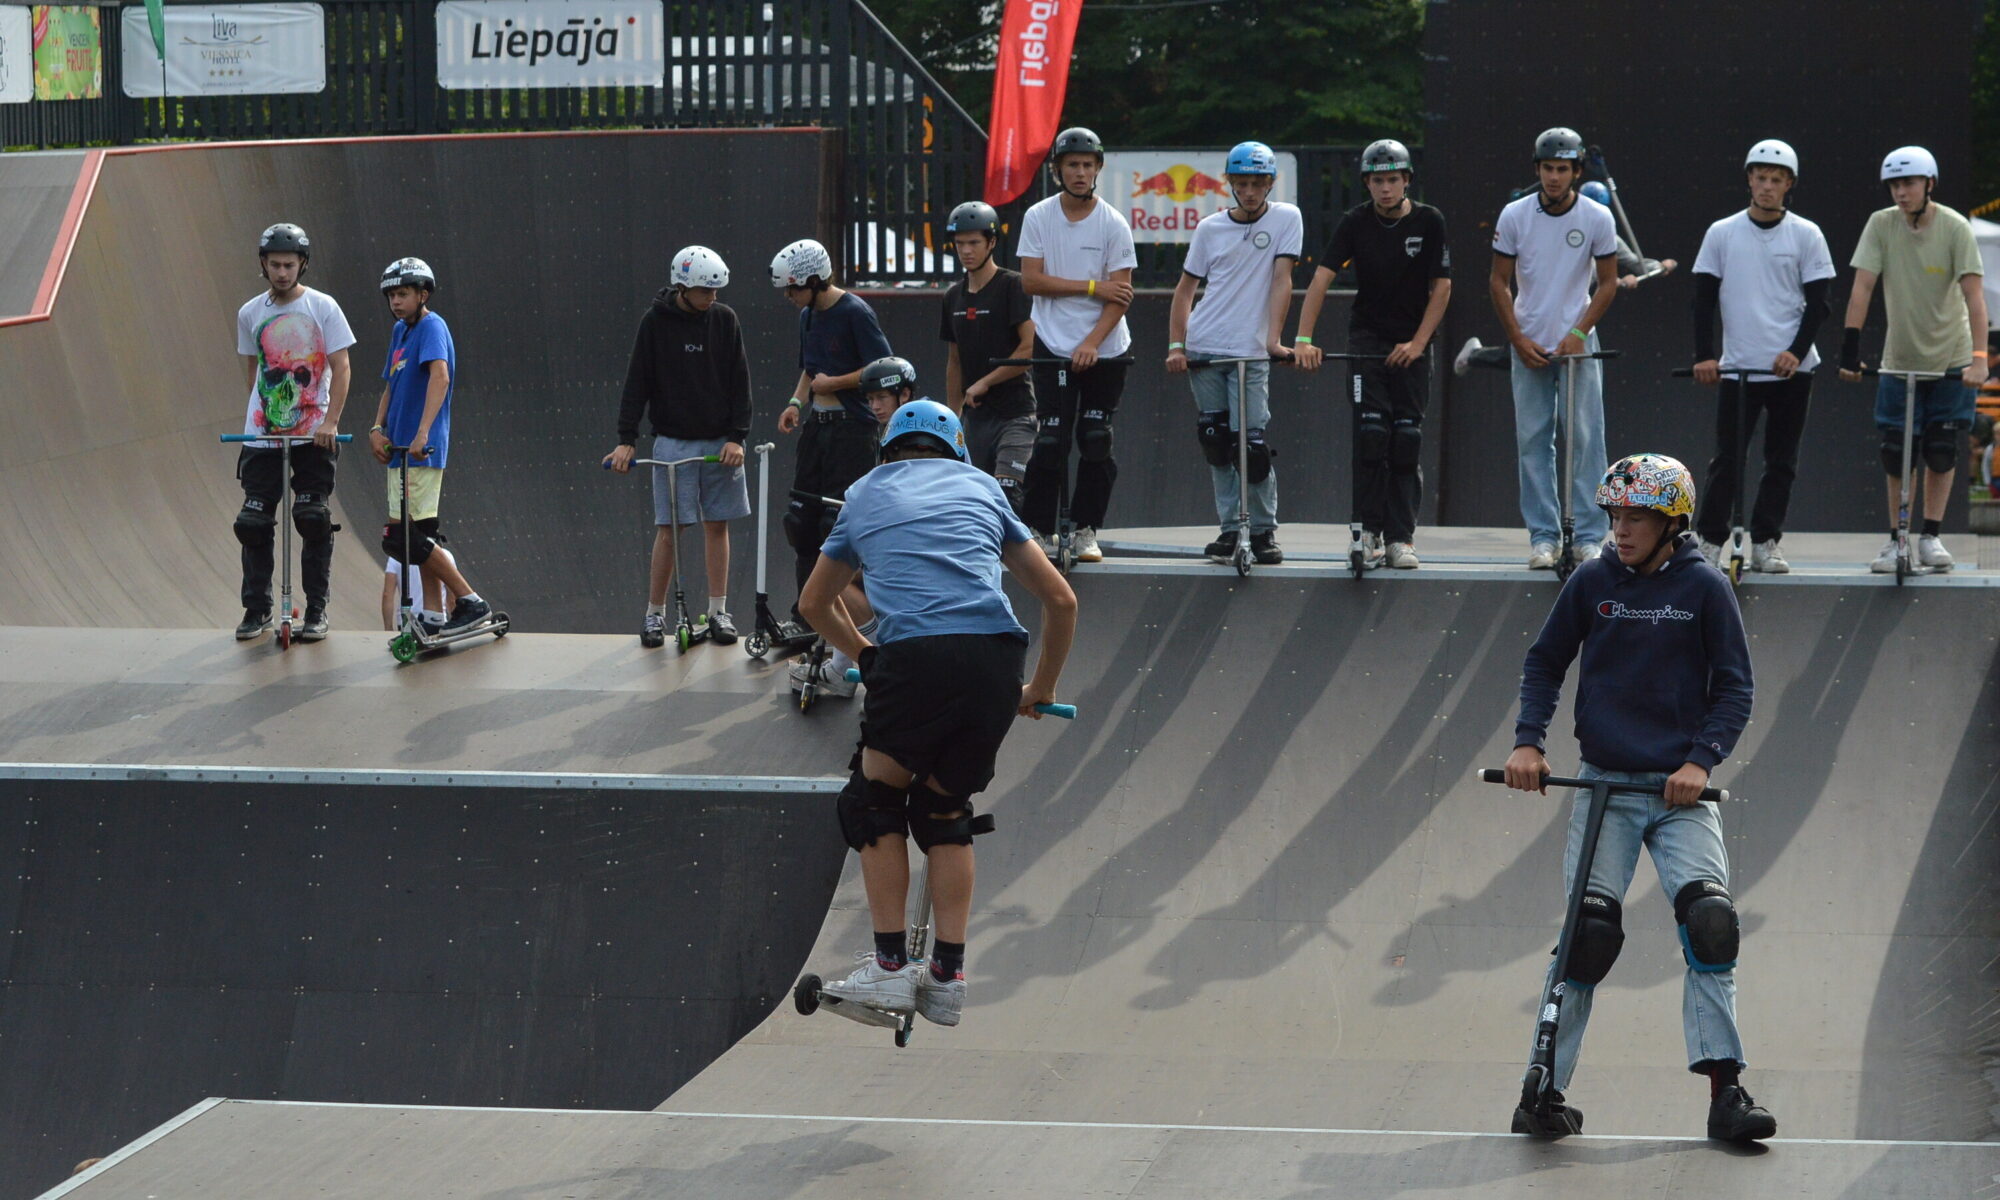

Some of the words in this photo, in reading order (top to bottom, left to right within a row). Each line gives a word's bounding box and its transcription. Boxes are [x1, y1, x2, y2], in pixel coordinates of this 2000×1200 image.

[472, 17, 618, 66] Liepāja
[1131, 207, 1179, 230] Red
[1597, 600, 1694, 625] Champion
